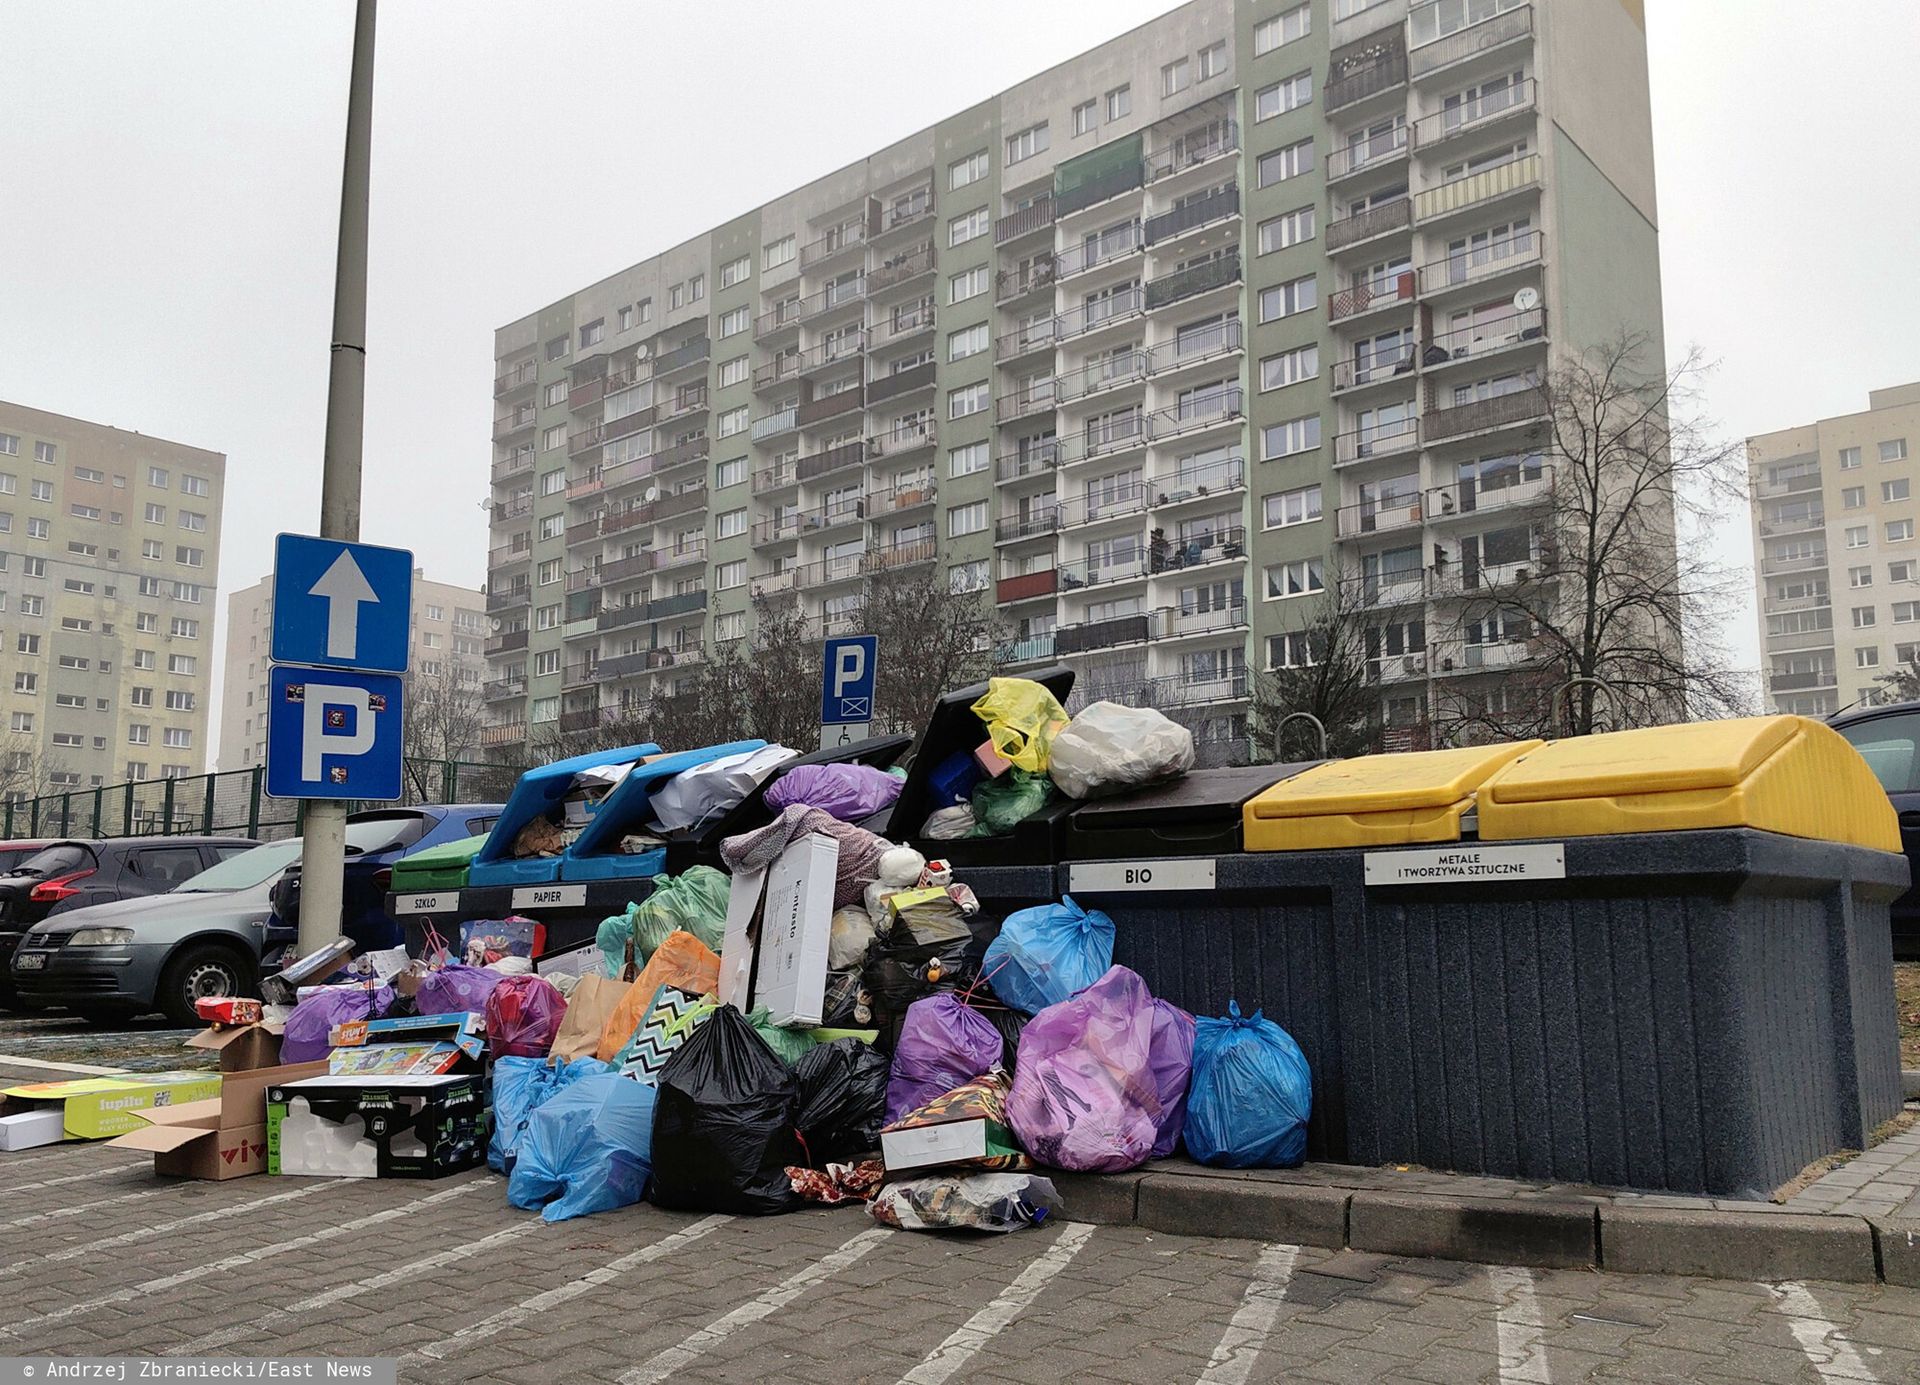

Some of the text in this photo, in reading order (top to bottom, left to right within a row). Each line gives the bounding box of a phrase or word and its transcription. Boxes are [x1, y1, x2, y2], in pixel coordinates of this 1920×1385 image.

[834, 645, 865, 698] P
[301, 683, 376, 782] P
[1438, 854, 1481, 865] METALE
[1125, 868, 1152, 884] BIO
[1398, 863, 1525, 878] I TWORZYWA SZTUCZNE
[533, 891, 562, 903] PAPIER
[787, 879, 802, 938] kontrasto
[99, 1096, 144, 1111] lupilu
